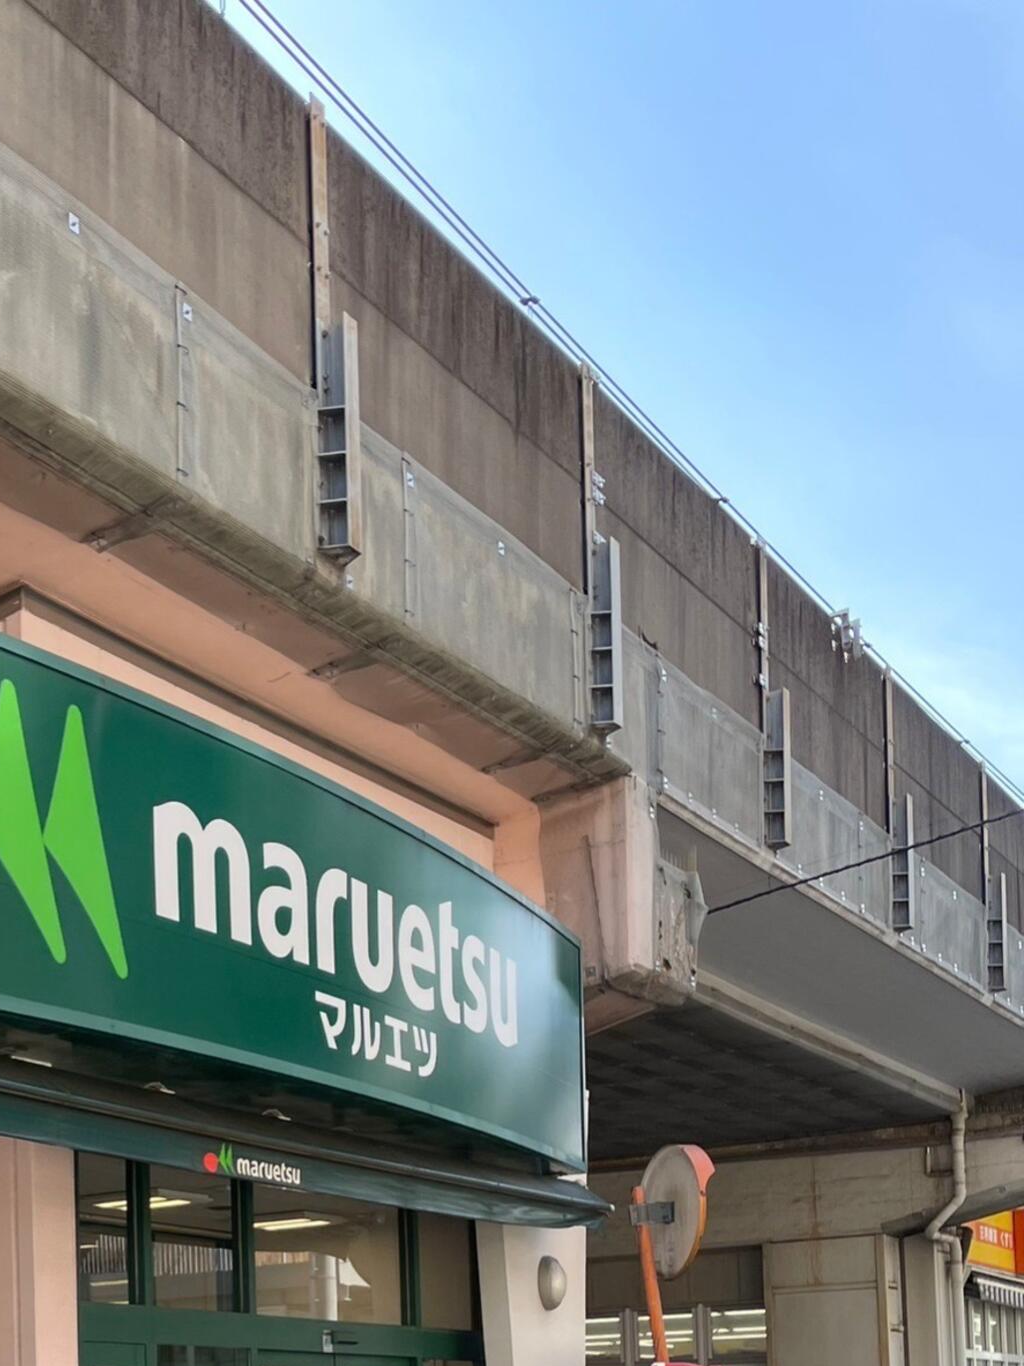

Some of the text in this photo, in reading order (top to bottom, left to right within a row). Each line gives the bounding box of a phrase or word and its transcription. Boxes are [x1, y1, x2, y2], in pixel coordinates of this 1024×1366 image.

[152, 800, 519, 1048] maruetsu
[314, 990, 439, 1078] マルエツ
[236, 1156, 302, 1186] maruetsu
